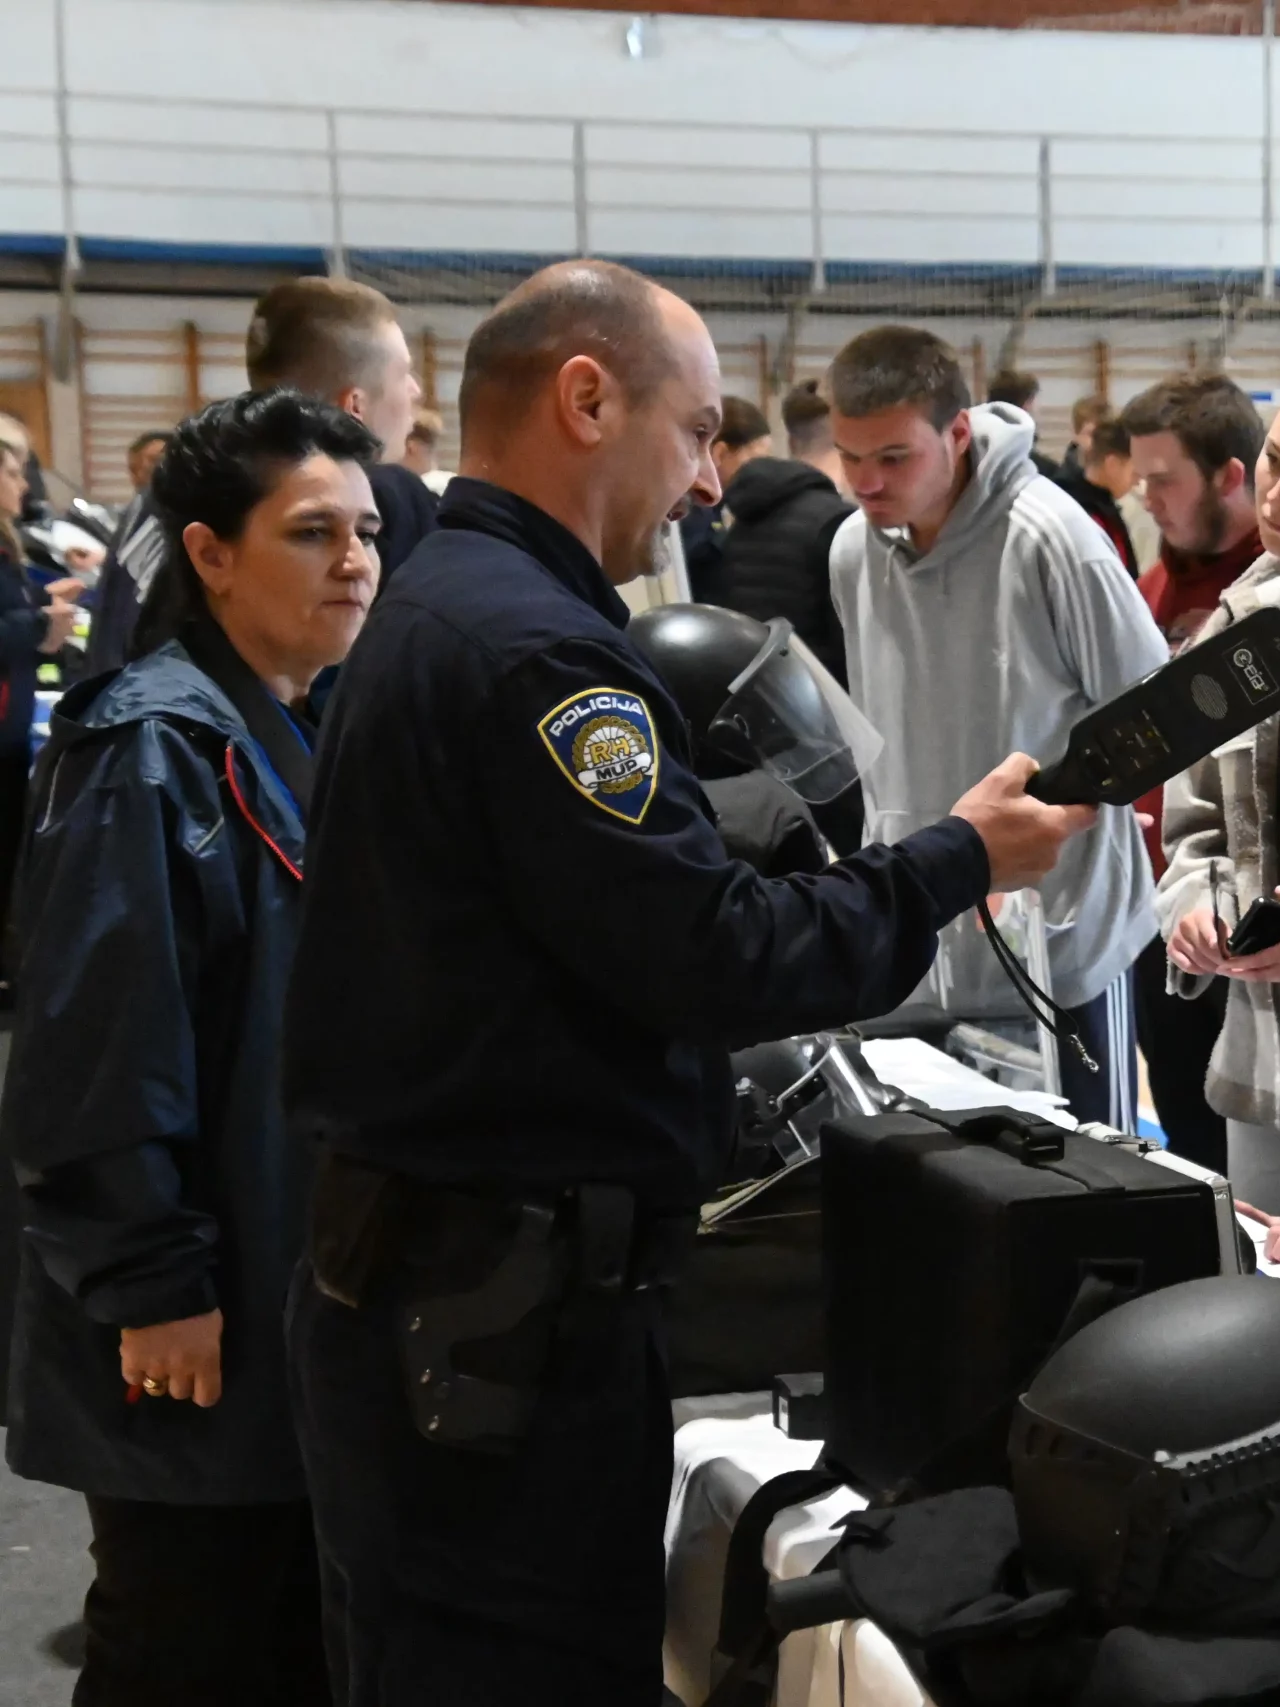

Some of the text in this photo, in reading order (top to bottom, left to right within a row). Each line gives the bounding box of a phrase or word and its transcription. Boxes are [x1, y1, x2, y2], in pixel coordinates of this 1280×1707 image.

[549, 696, 643, 737] POLICIJA
[590, 736, 631, 764] RH
[596, 759, 637, 781] MUP
